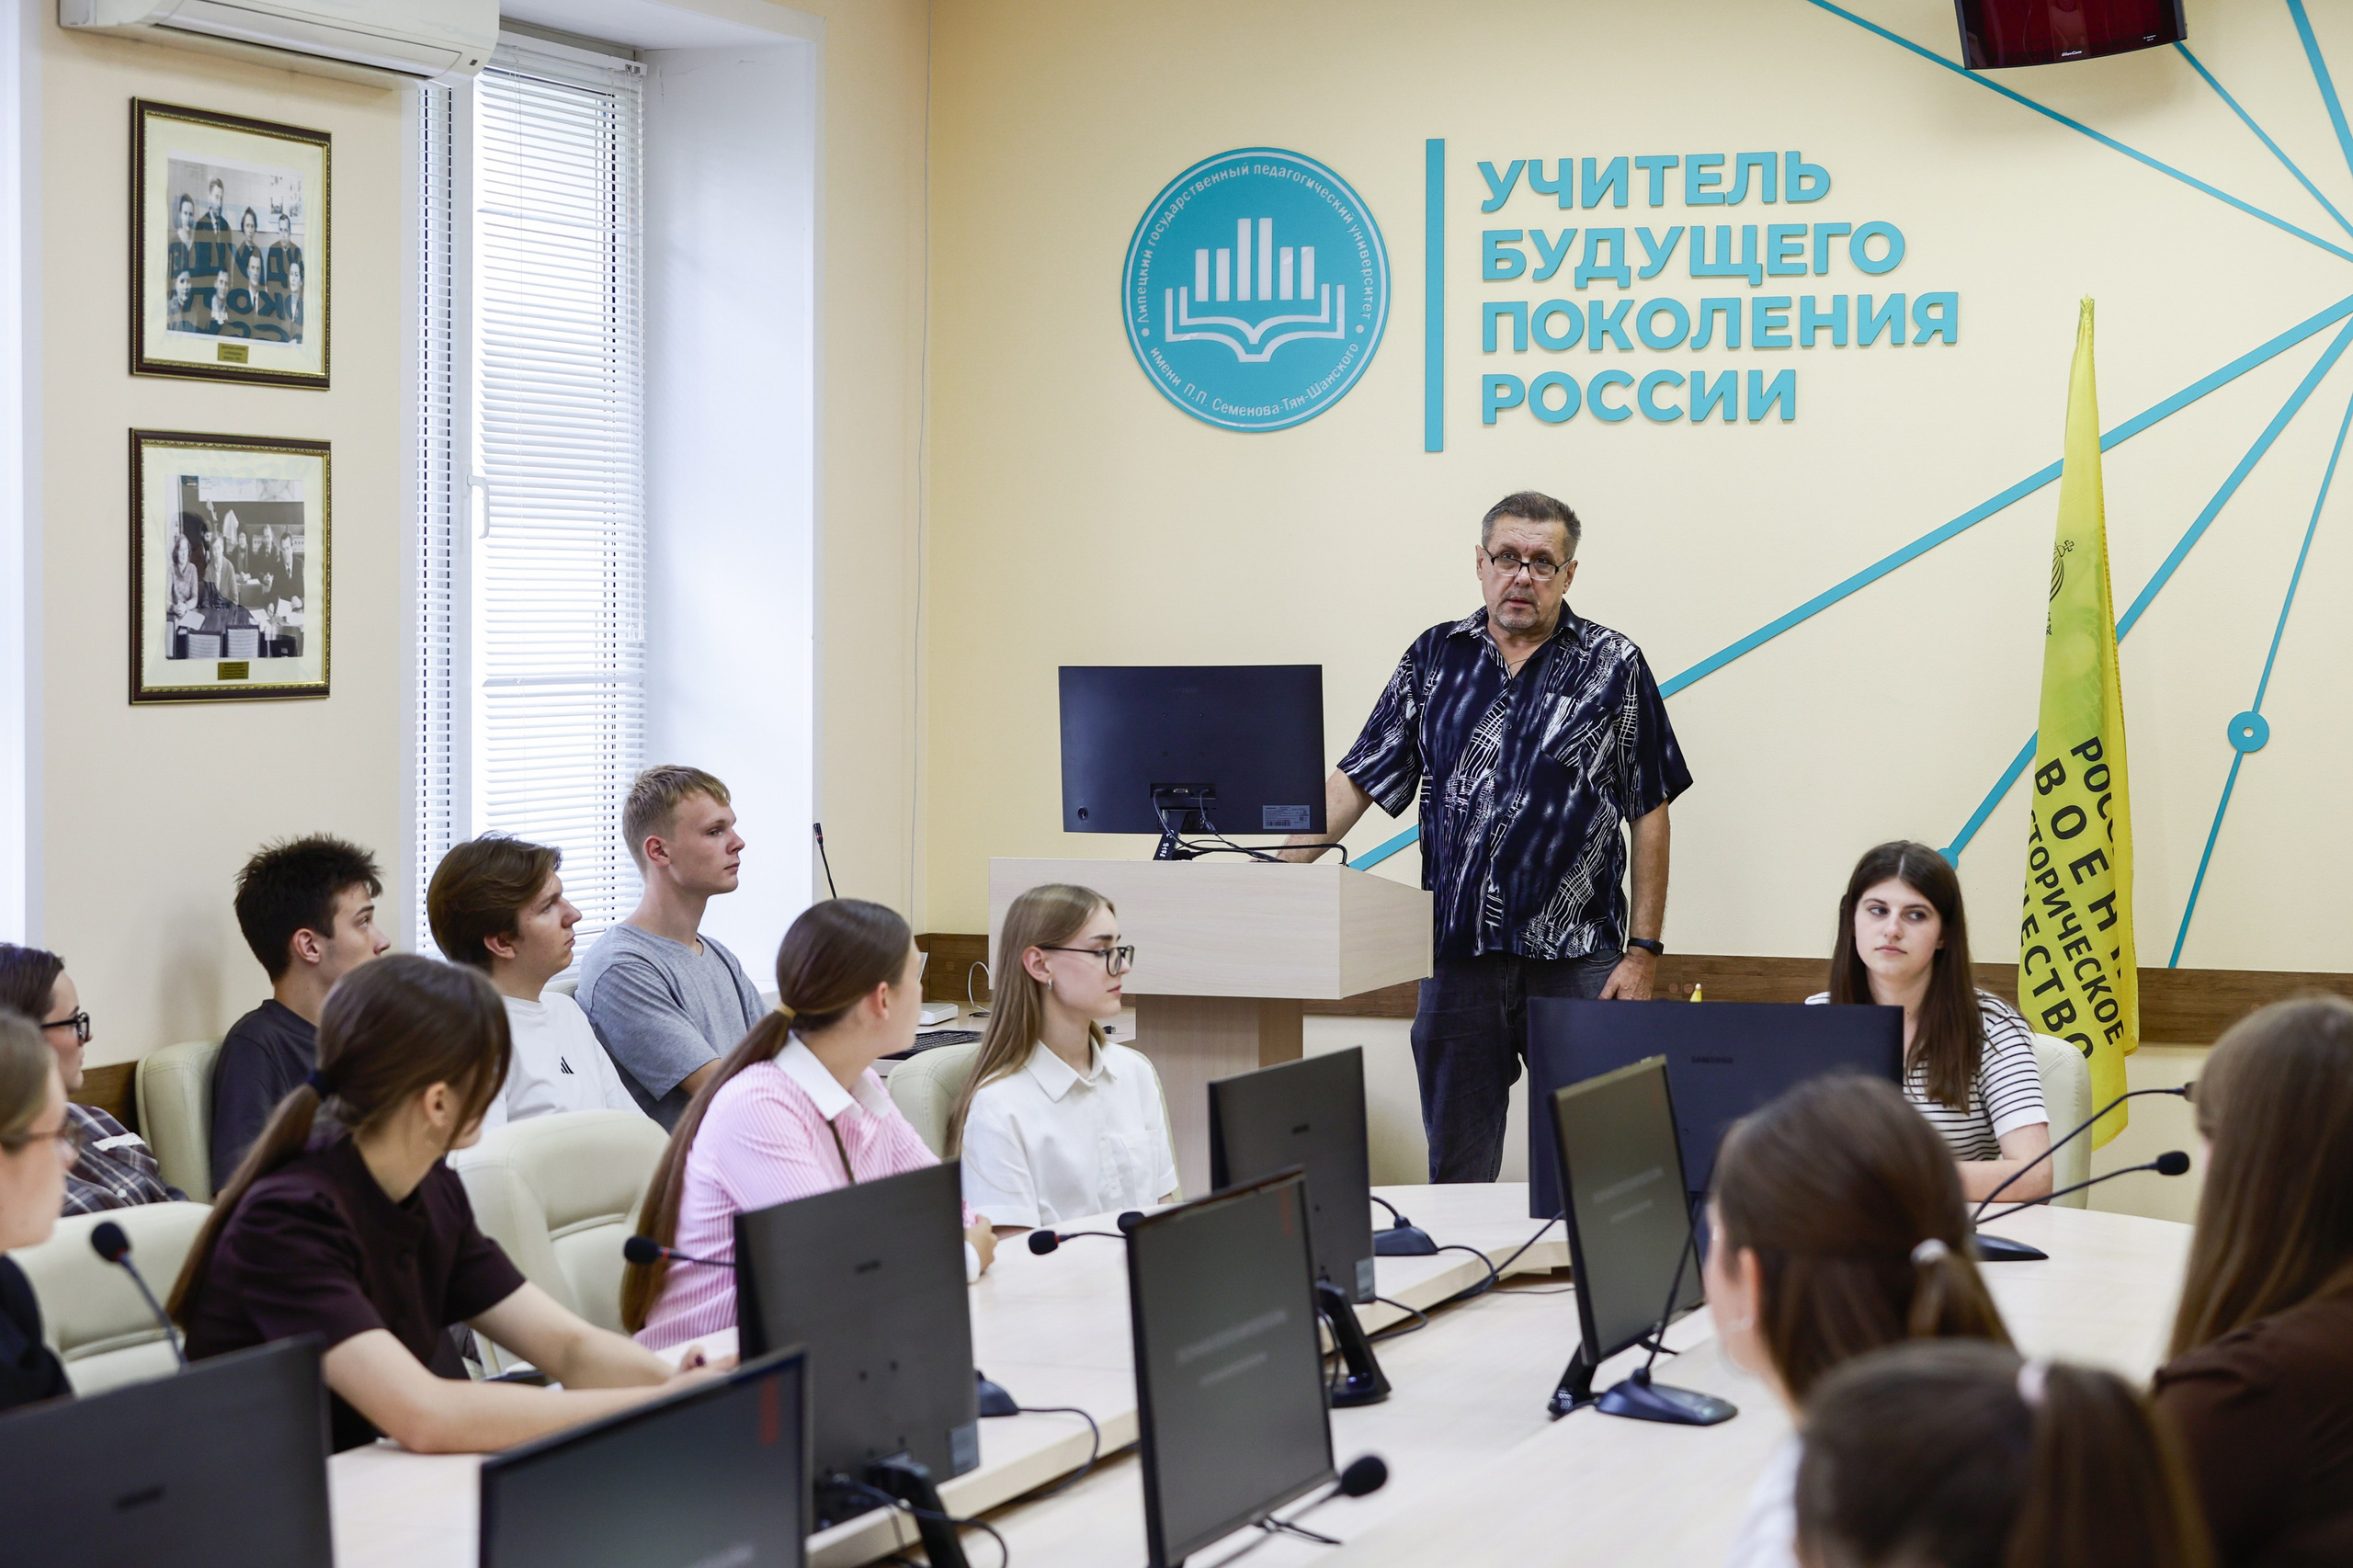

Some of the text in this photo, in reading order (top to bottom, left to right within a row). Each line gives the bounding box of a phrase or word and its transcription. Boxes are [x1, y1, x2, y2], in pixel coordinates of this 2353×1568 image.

[1477, 151, 1831, 212] УЧИТЕЛЬ
[1136, 162, 1374, 323] Липецкий государственный педагогический университет
[1482, 221, 1905, 289] БУДУЩЕГО
[1482, 291, 1959, 352] ПОКОЛЕНИЯ
[1149, 344, 1358, 416] имени П.П. Семенова-Тян-Шанского
[1482, 369, 1796, 425] РОССИИ
[2070, 736, 2114, 857] РОС
[2020, 880, 2094, 1059] ЕСТВО
